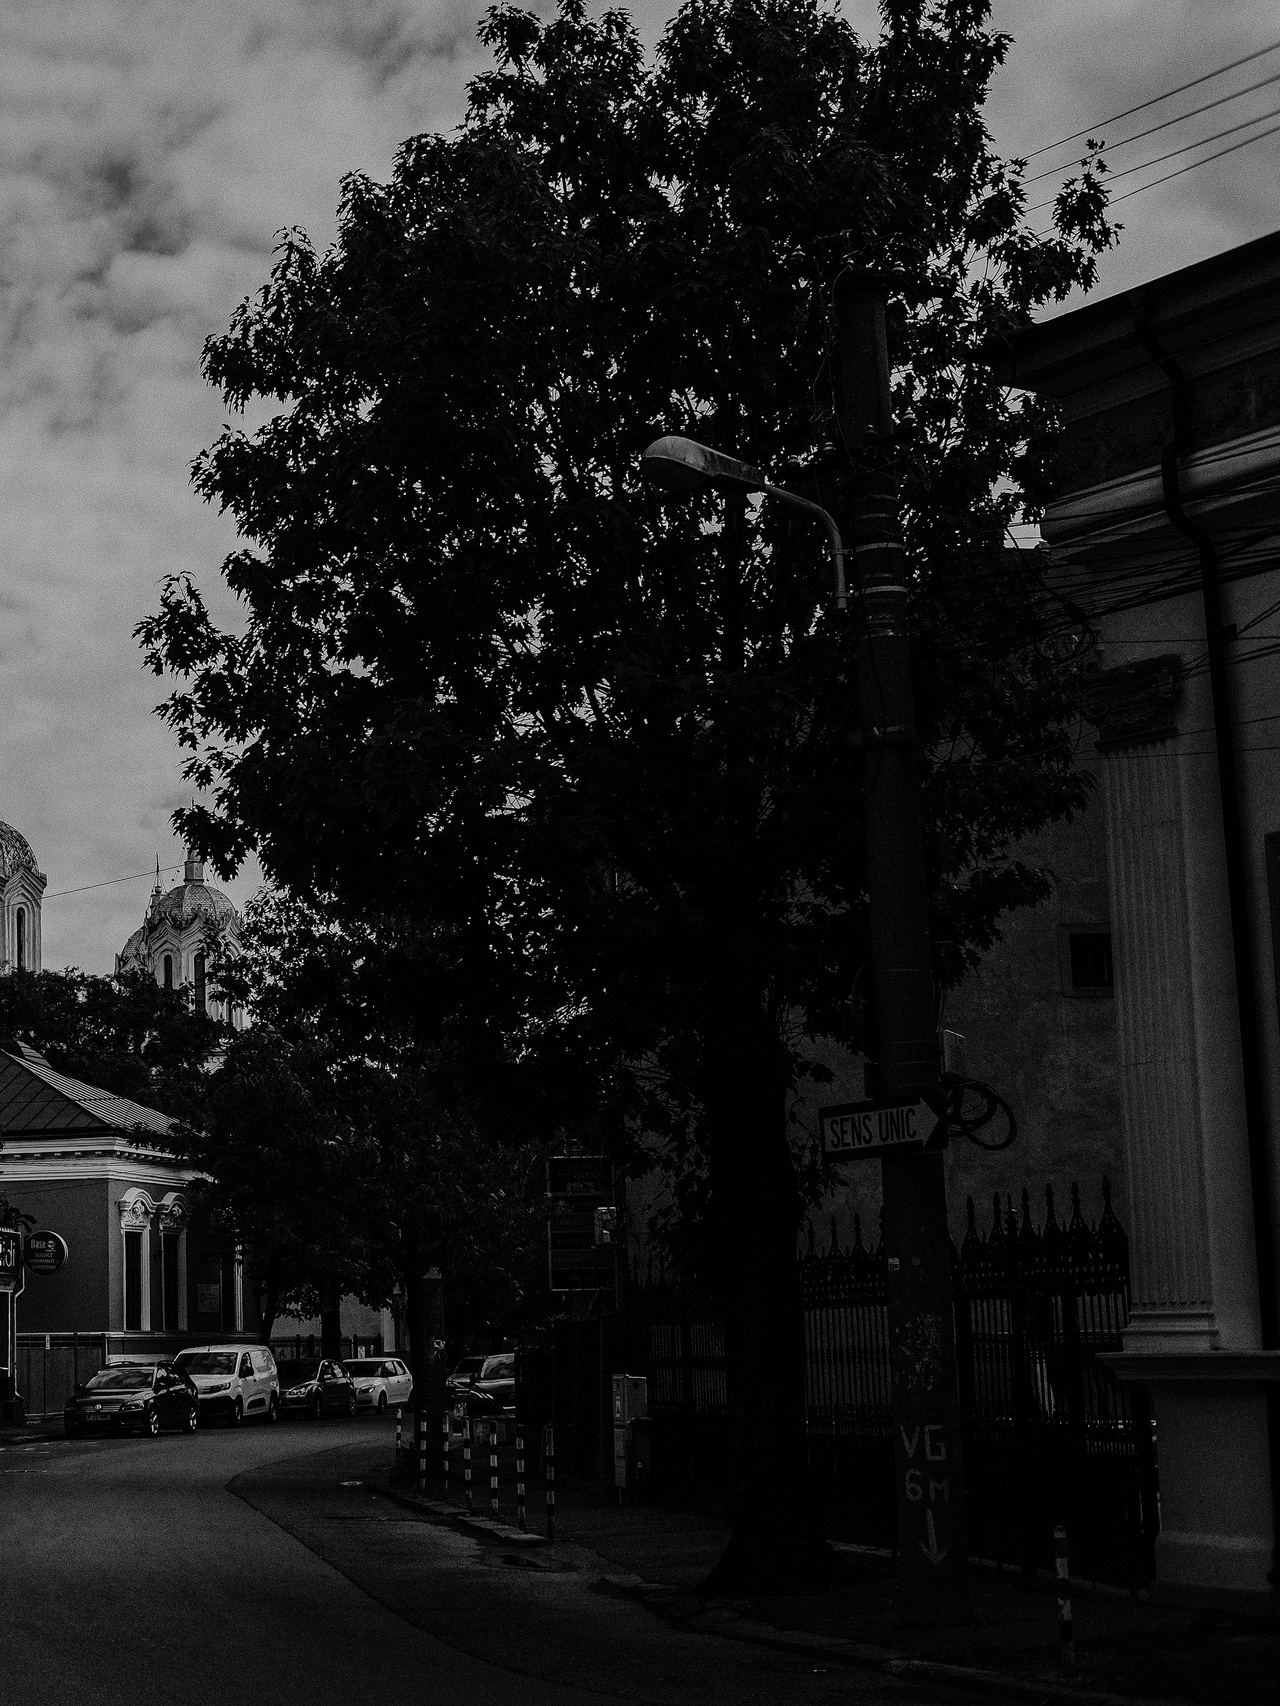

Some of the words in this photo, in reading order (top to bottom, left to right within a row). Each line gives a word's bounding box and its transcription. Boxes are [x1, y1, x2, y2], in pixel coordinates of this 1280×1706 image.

[830, 1114, 873, 1149] SENS
[877, 1107, 917, 1142] UNIC
[899, 1423, 947, 1462] VG
